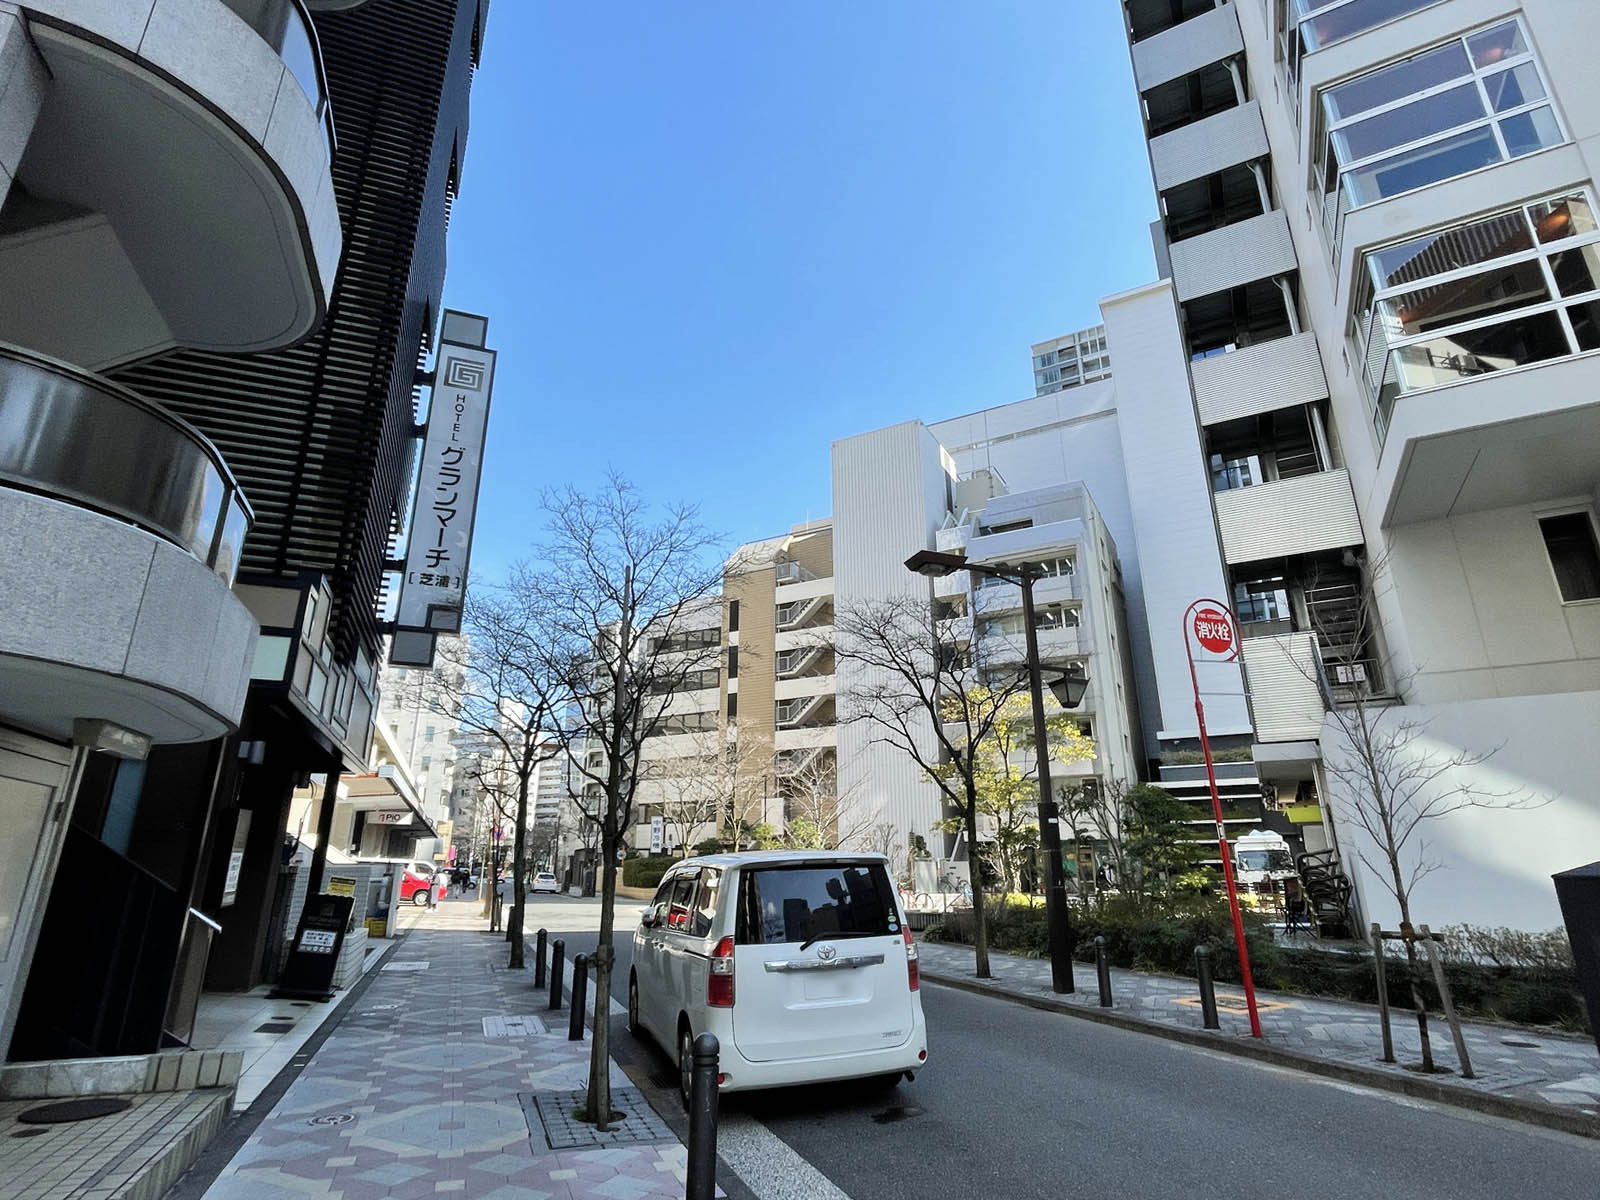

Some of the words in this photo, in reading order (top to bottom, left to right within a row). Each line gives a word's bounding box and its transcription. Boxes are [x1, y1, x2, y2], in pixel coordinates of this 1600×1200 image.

[451, 394, 466, 442] HOTEL
[425, 446, 466, 568] グランマーチ
[1196, 621, 1230, 640] 消火栓
